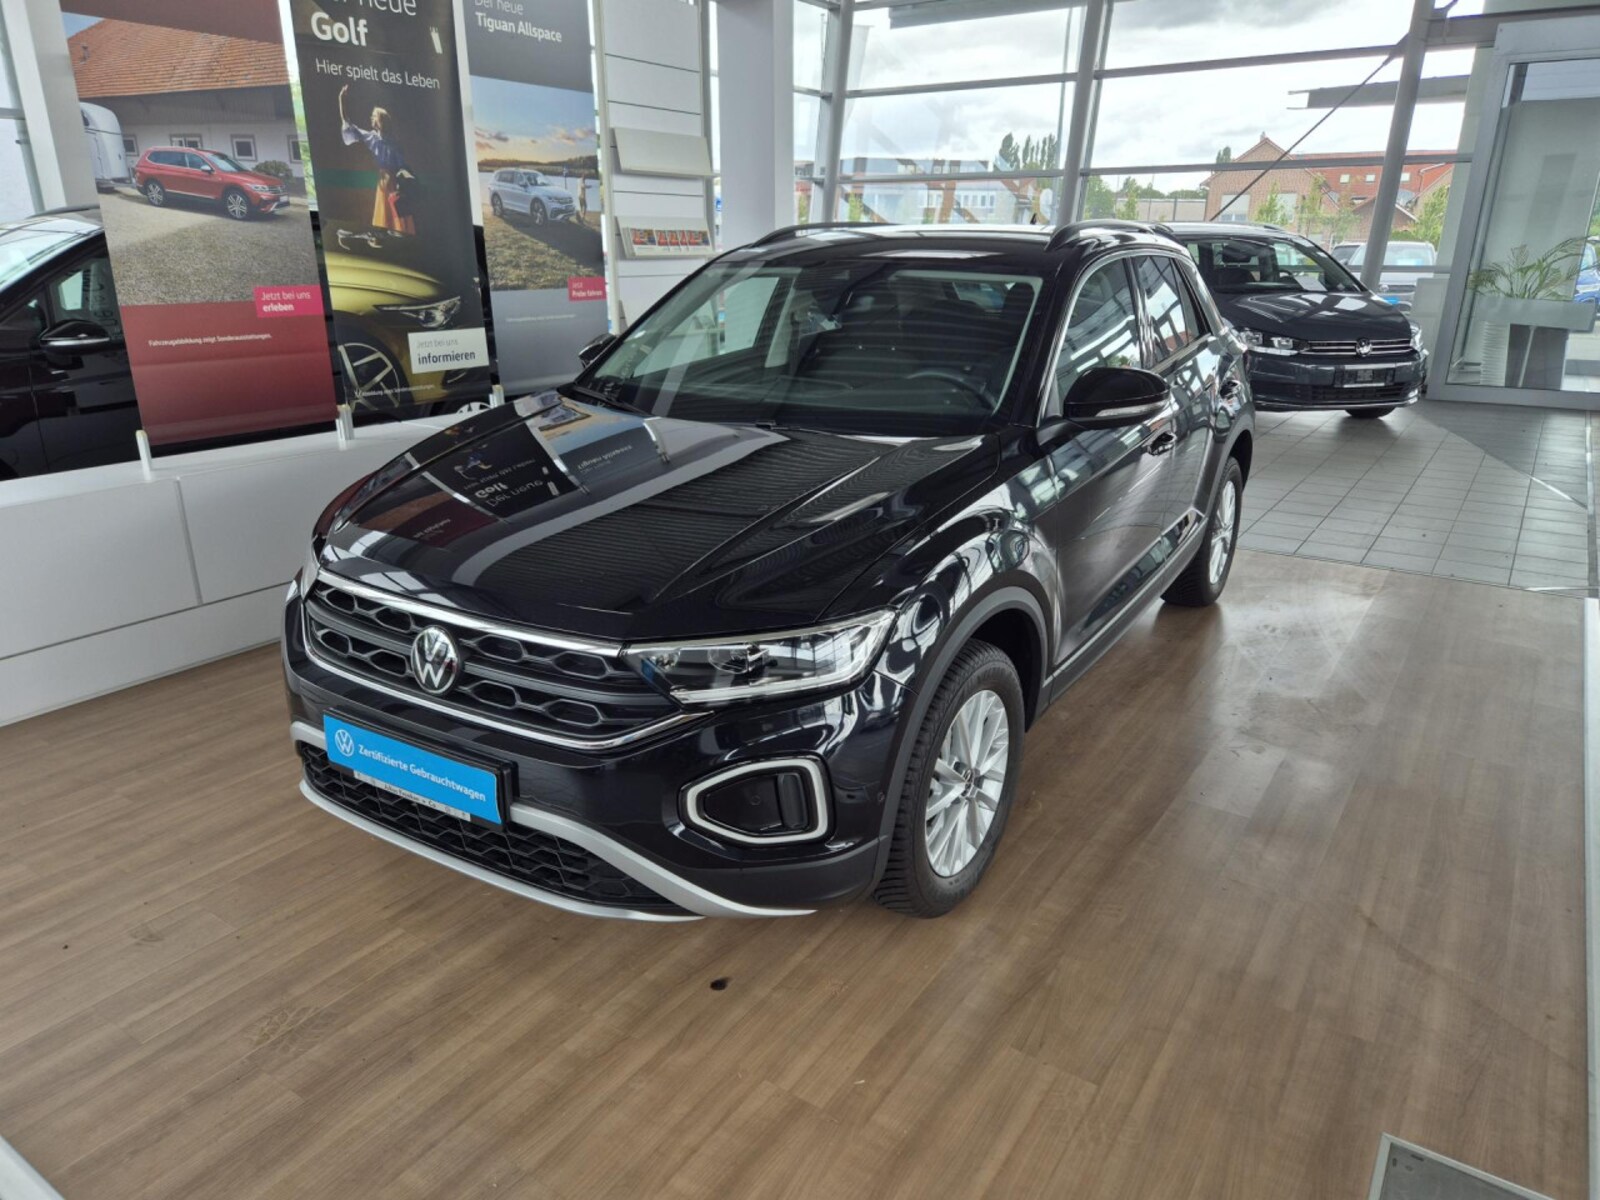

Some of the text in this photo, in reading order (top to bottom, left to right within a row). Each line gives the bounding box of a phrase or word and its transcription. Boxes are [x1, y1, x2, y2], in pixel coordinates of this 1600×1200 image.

[496, 0, 524, 15] neue
[311, 11, 368, 46] Golf
[475, 11, 562, 42] Tiguan Allspace
[315, 57, 441, 89] Hier spielt das Leben
[262, 290, 311, 301] Jetzt bei uns
[262, 302, 295, 312] erleben
[417, 340, 433, 349] Jetzt
[446, 338, 459, 347] uns
[418, 350, 477, 365] informieren
[358, 744, 408, 771] Zertifizierte
[409, 763, 486, 802] Gebrauchtwagen
